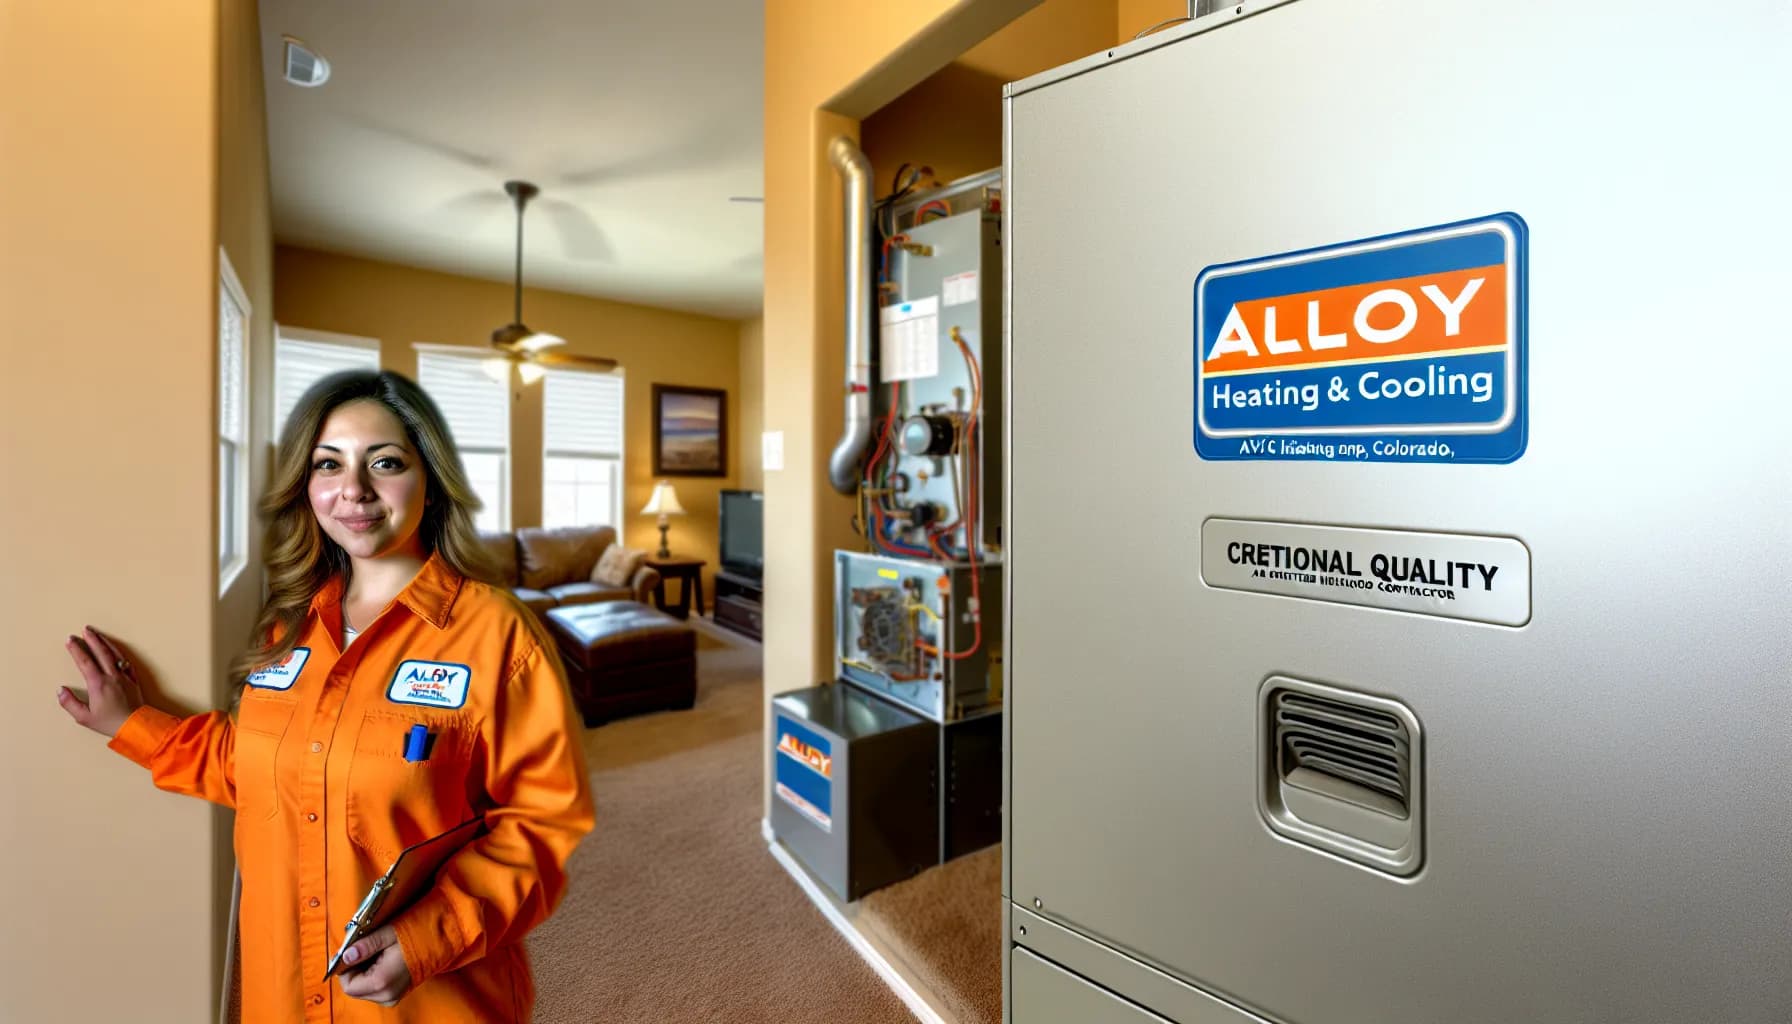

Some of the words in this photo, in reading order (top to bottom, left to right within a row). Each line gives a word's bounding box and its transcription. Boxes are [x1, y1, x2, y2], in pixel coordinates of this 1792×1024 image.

[1207, 278, 1486, 361] ALLOY
[1213, 379, 1320, 411] Heating
[1327, 376, 1350, 402] &
[1358, 365, 1493, 403] Cooling
[1373, 440, 1455, 458] Colorado,
[1228, 542, 1361, 576] CRETIONAL
[1370, 554, 1500, 590] QUALITY
